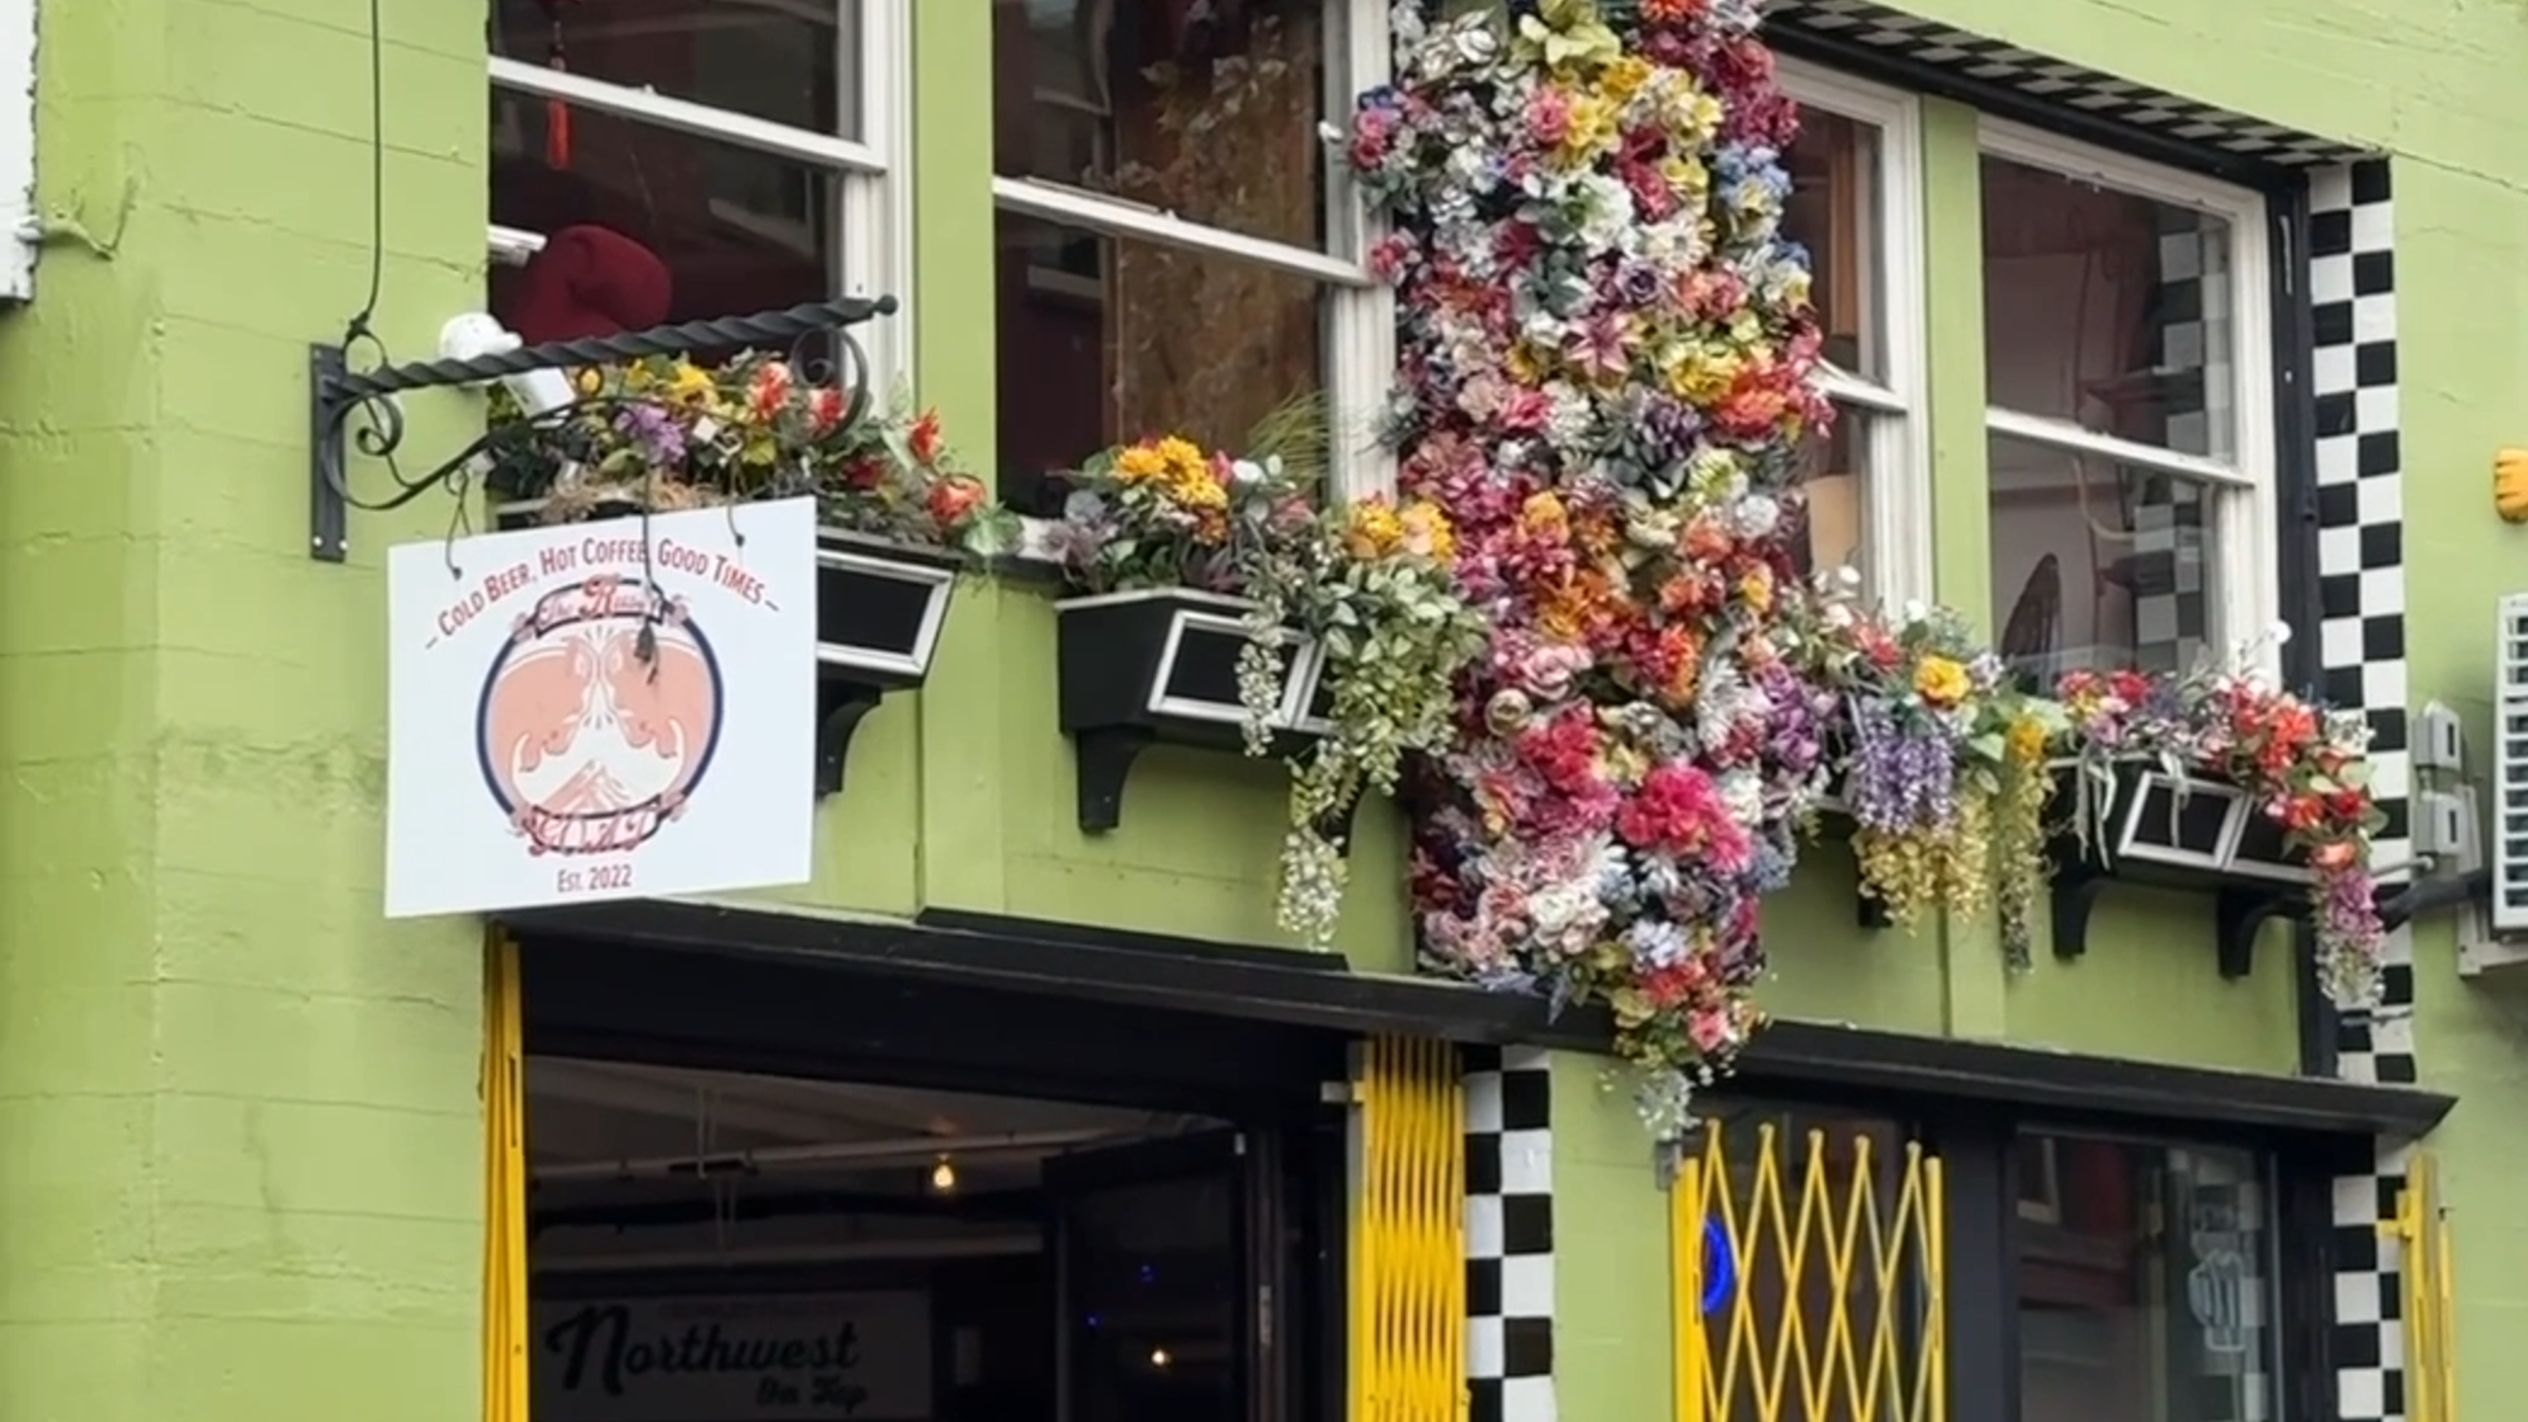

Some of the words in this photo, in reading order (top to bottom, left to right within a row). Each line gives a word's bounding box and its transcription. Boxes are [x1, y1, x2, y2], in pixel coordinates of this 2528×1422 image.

[588, 864, 632, 891] 2022
[545, 1303, 861, 1397] Northwest
[755, 1375, 800, 1407] On
